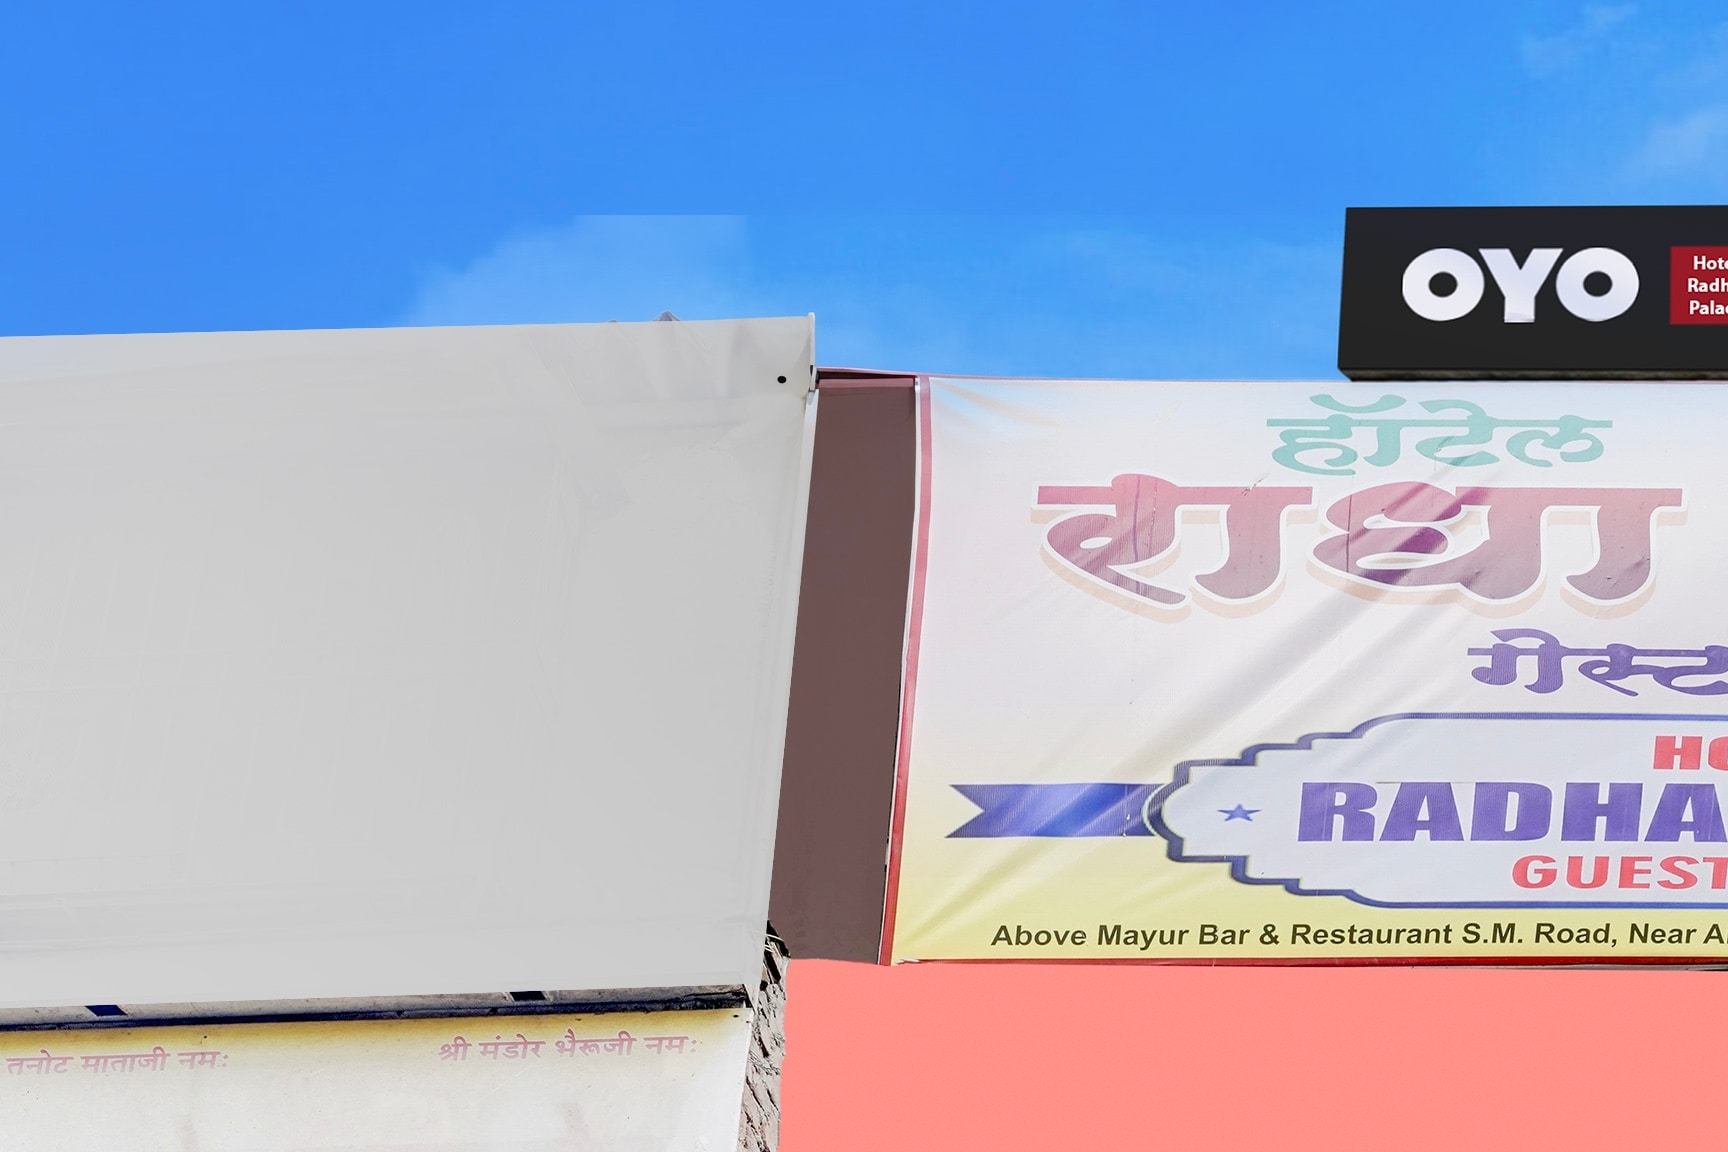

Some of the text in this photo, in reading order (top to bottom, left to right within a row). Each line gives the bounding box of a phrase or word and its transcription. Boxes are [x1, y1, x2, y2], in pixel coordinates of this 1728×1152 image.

[1402, 247, 1640, 323] OYO
[1266, 393, 1614, 476] हॉटेल
[1034, 474, 1684, 612] राधा
[1297, 781, 1726, 842] RADHA
[991, 924, 1087, 947] Above
[1097, 924, 1190, 951] Mayur
[1199, 924, 1250, 946] Bar
[1258, 924, 1281, 946] &
[1290, 923, 1453, 946] Restaurant
[1461, 923, 1524, 944] S.M.
[1534, 923, 1618, 948] Road,
[1628, 923, 1697, 945] Near
[6, 1049, 74, 1075] तनोट
[80, 1046, 171, 1073] माताजी
[438, 1035, 472, 1061] श्री
[478, 1033, 546, 1060] मंडोर
